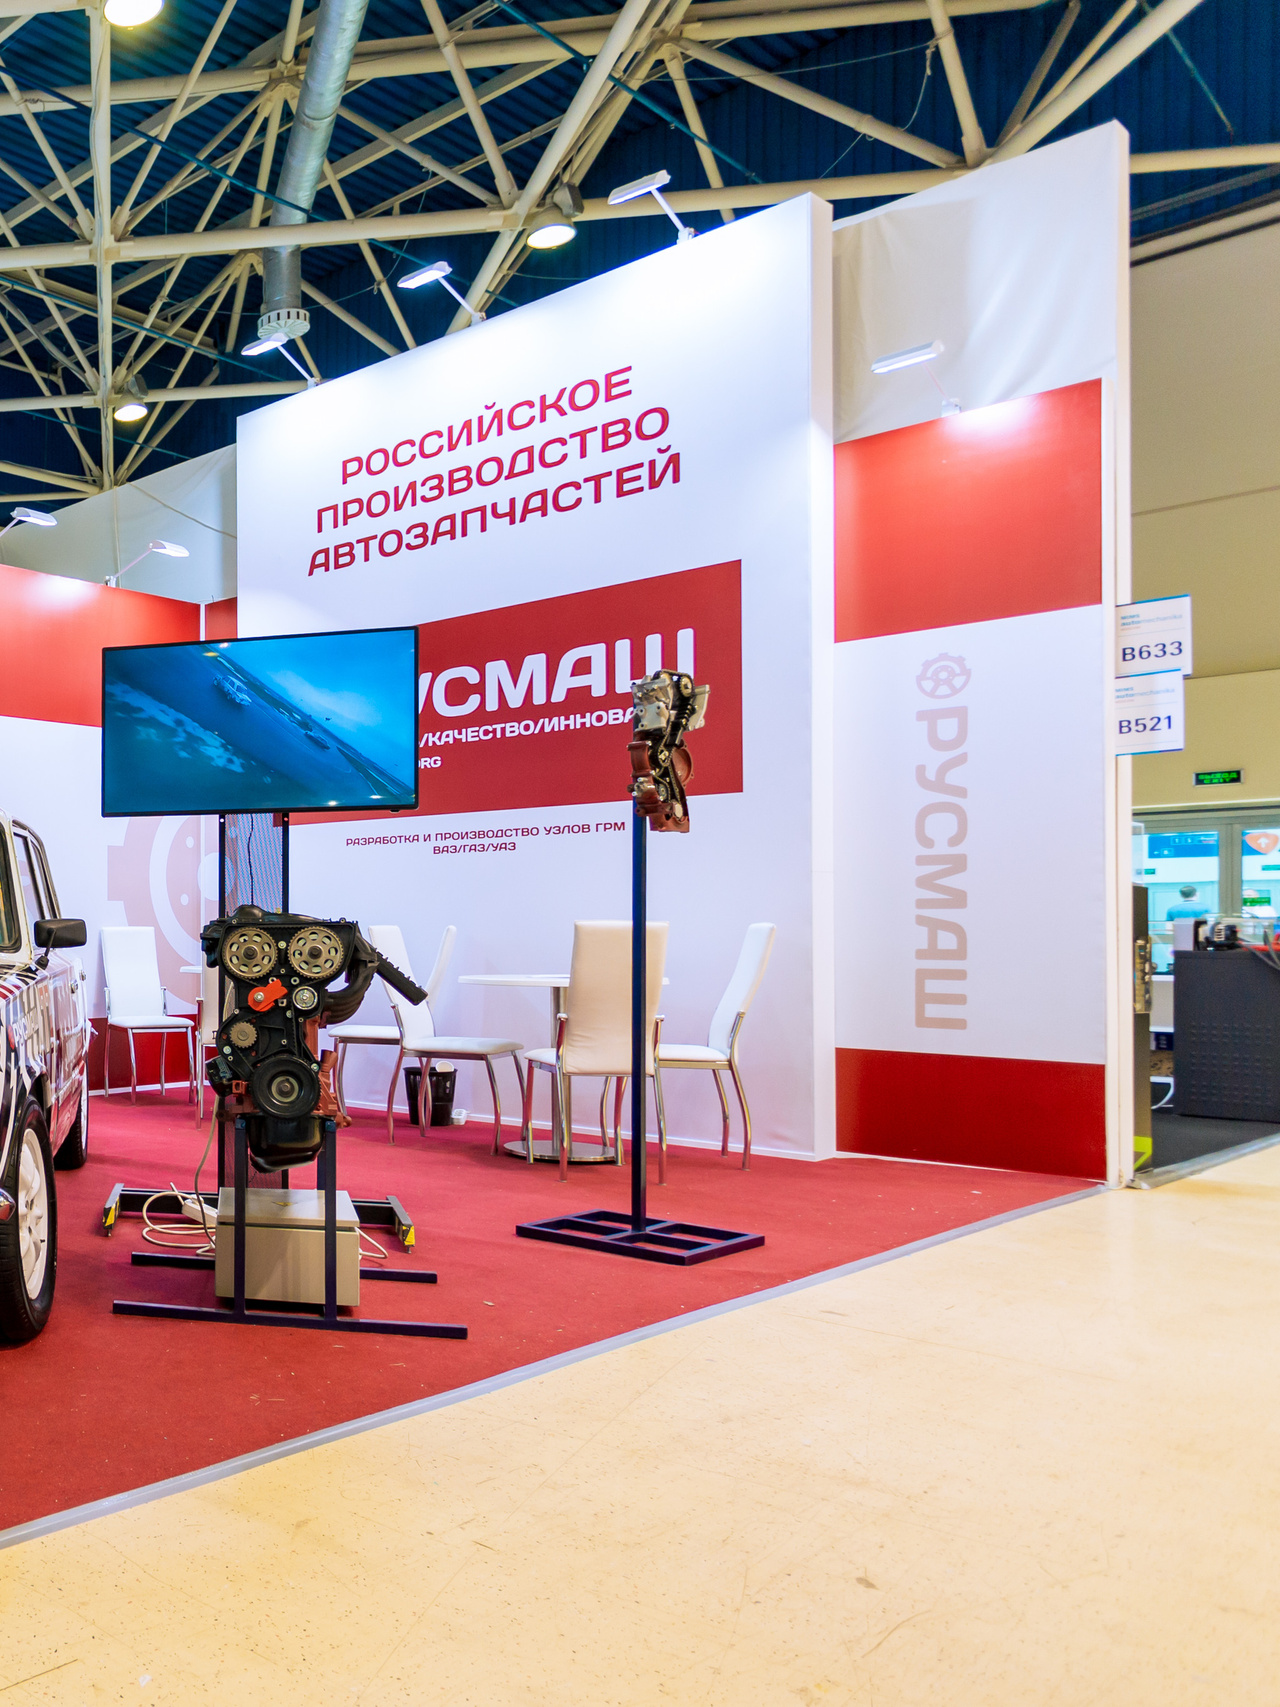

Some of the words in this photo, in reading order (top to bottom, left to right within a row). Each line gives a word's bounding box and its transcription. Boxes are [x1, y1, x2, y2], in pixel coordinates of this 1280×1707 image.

[317, 407, 669, 534] ПРОИЗВОДСТВО
[342, 365, 632, 485] РОССИЙСКОЕ
[308, 444, 681, 576] АВТОЗАПЧАСТЕЙ
[419, 627, 694, 718] СМАШ
[1122, 641, 1183, 662] B633
[1119, 715, 1172, 735] B521
[346, 834, 419, 847] РАЗРАБОТКА
[423, 833, 431, 842] И
[435, 827, 540, 842] ПРОИЗВОДСТВО
[544, 823, 591, 836] УЗЛОВ
[595, 821, 626, 833] ГРМ
[433, 841, 516, 855] ВАЗ/ГАЗ/УАЗ
[915, 705, 968, 1030] РУСМАШ
